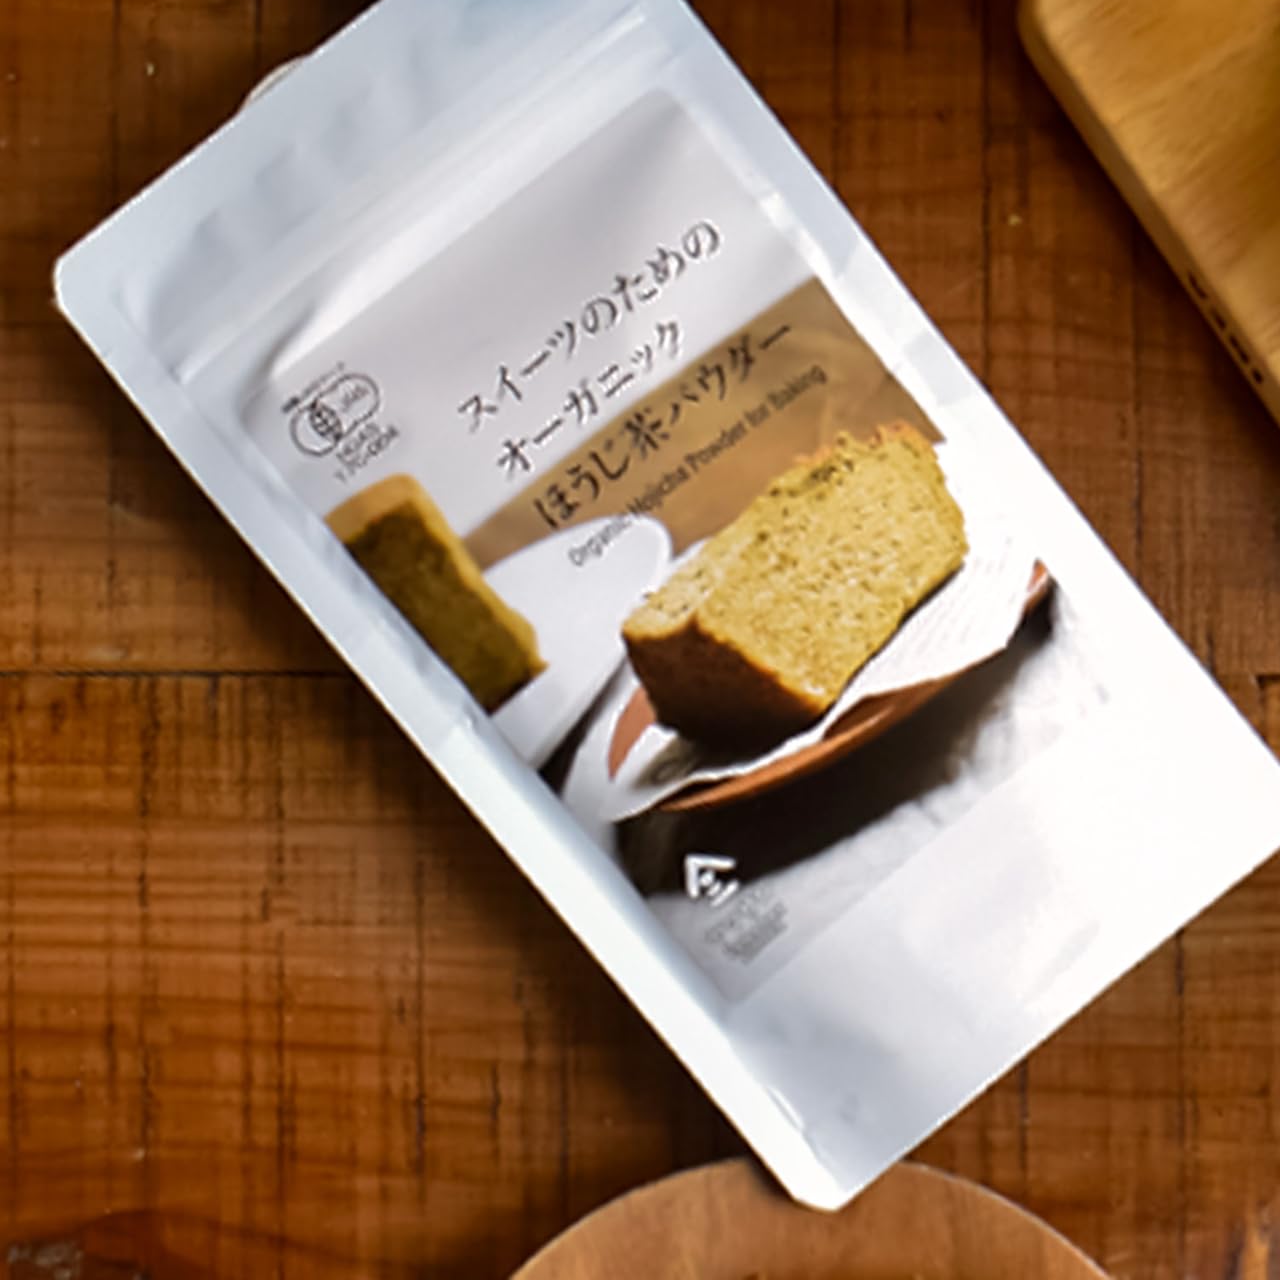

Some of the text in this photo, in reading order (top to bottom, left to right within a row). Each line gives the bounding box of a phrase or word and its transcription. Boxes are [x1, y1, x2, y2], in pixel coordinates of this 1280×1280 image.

[457, 220, 720, 433] スイーツのための
[497, 321, 680, 477] オーガニック
[534, 323, 791, 528] ほうじ茶パウダー
